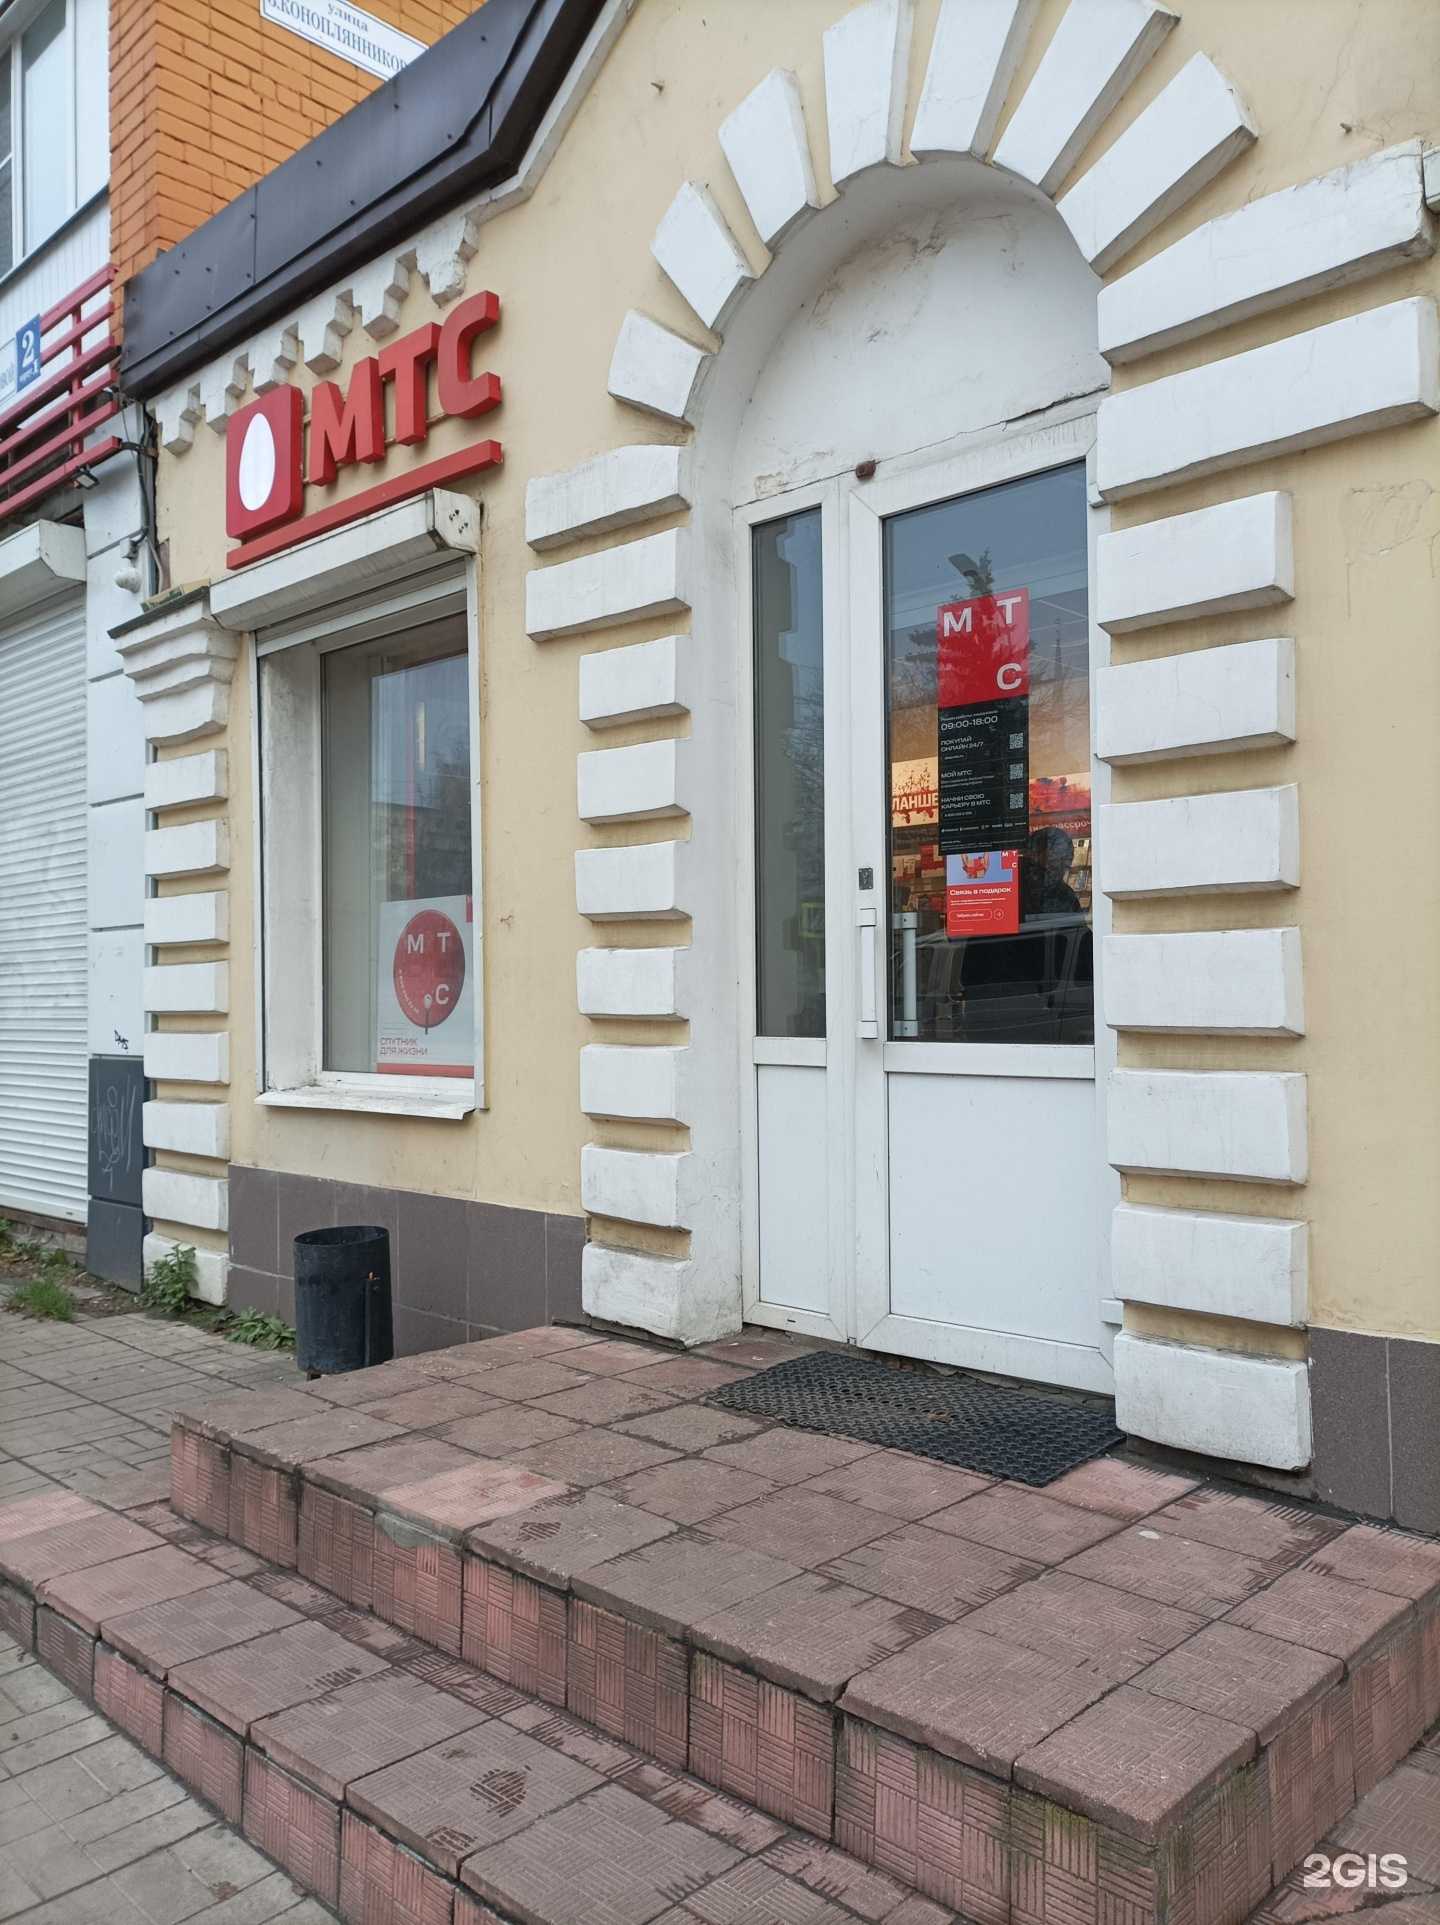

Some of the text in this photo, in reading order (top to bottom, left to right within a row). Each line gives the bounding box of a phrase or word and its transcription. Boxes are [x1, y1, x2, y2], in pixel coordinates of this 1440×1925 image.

[328, 3, 369, 32] улица
[22, 330, 35, 369] 2
[309, 289, 502, 488] МТС
[941, 715, 998, 731] 09:00-18:00
[979, 887, 1011, 896] подарок
